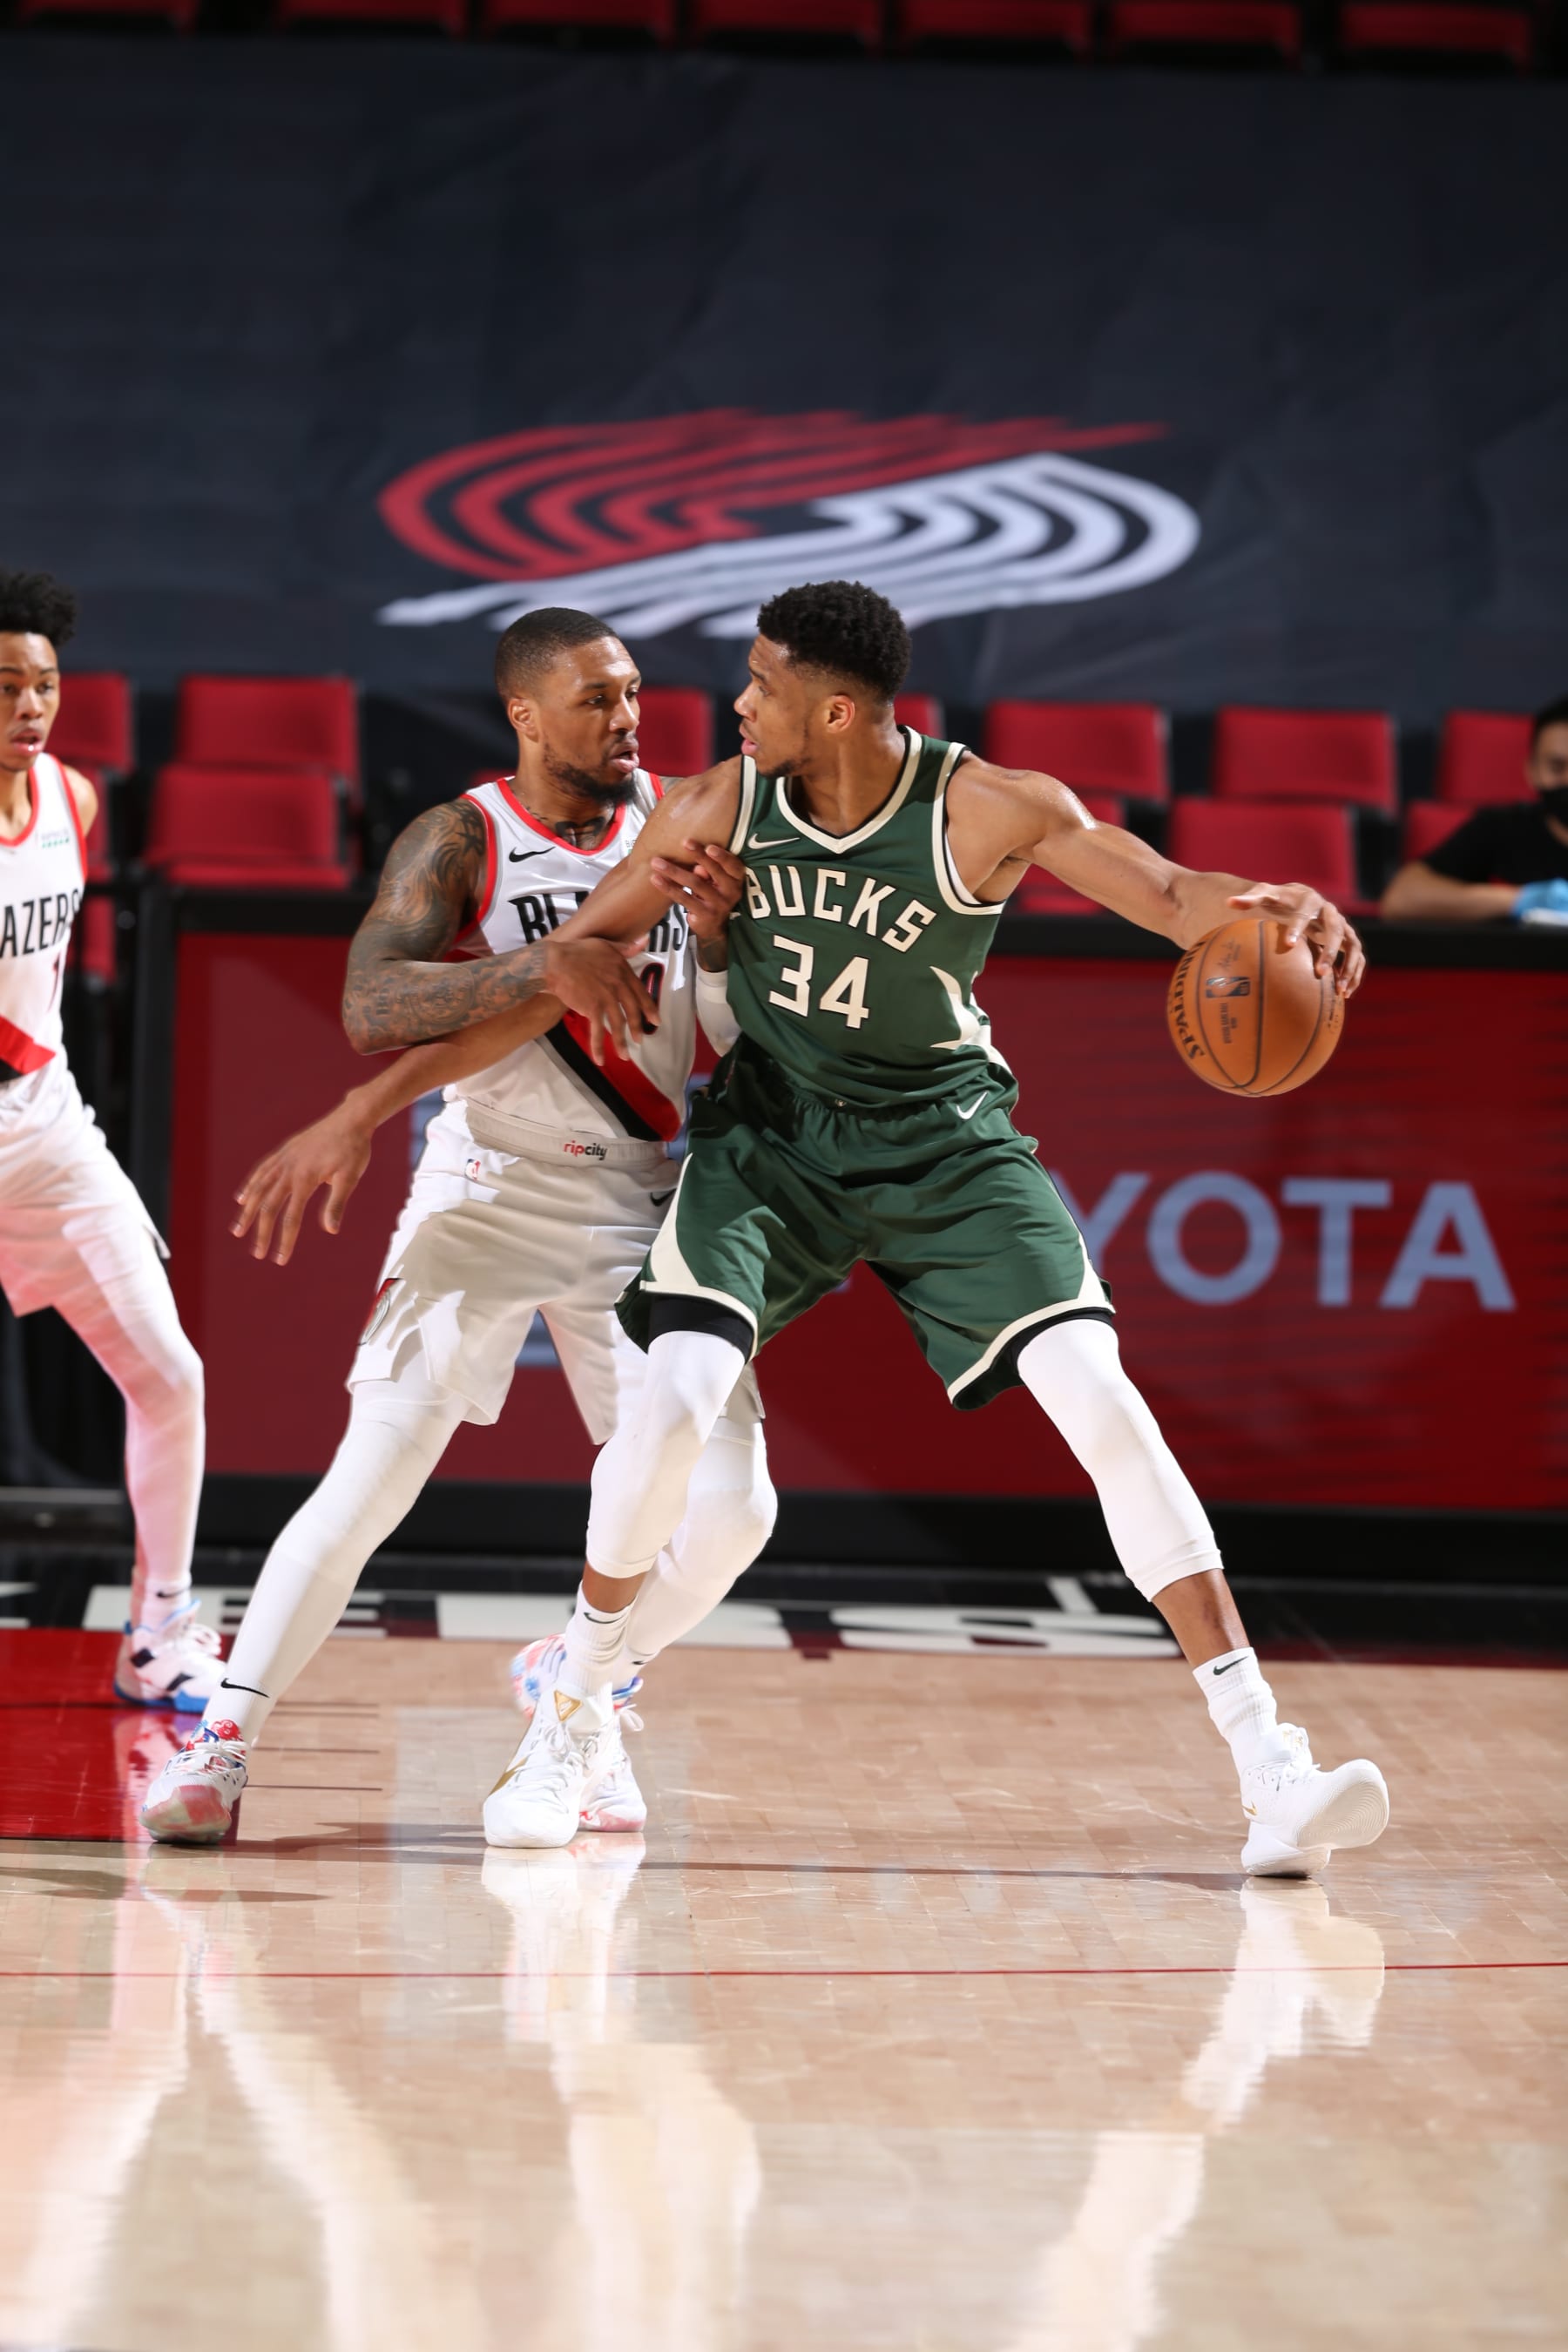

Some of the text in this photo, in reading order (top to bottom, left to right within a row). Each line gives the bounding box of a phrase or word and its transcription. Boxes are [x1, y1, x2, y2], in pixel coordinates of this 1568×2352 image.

[745, 864, 937, 953] BUCKS
[768, 935, 870, 1030] 34
[563, 1139, 608, 1161] ripcity
[1046, 1168, 1517, 1312] YOTA
